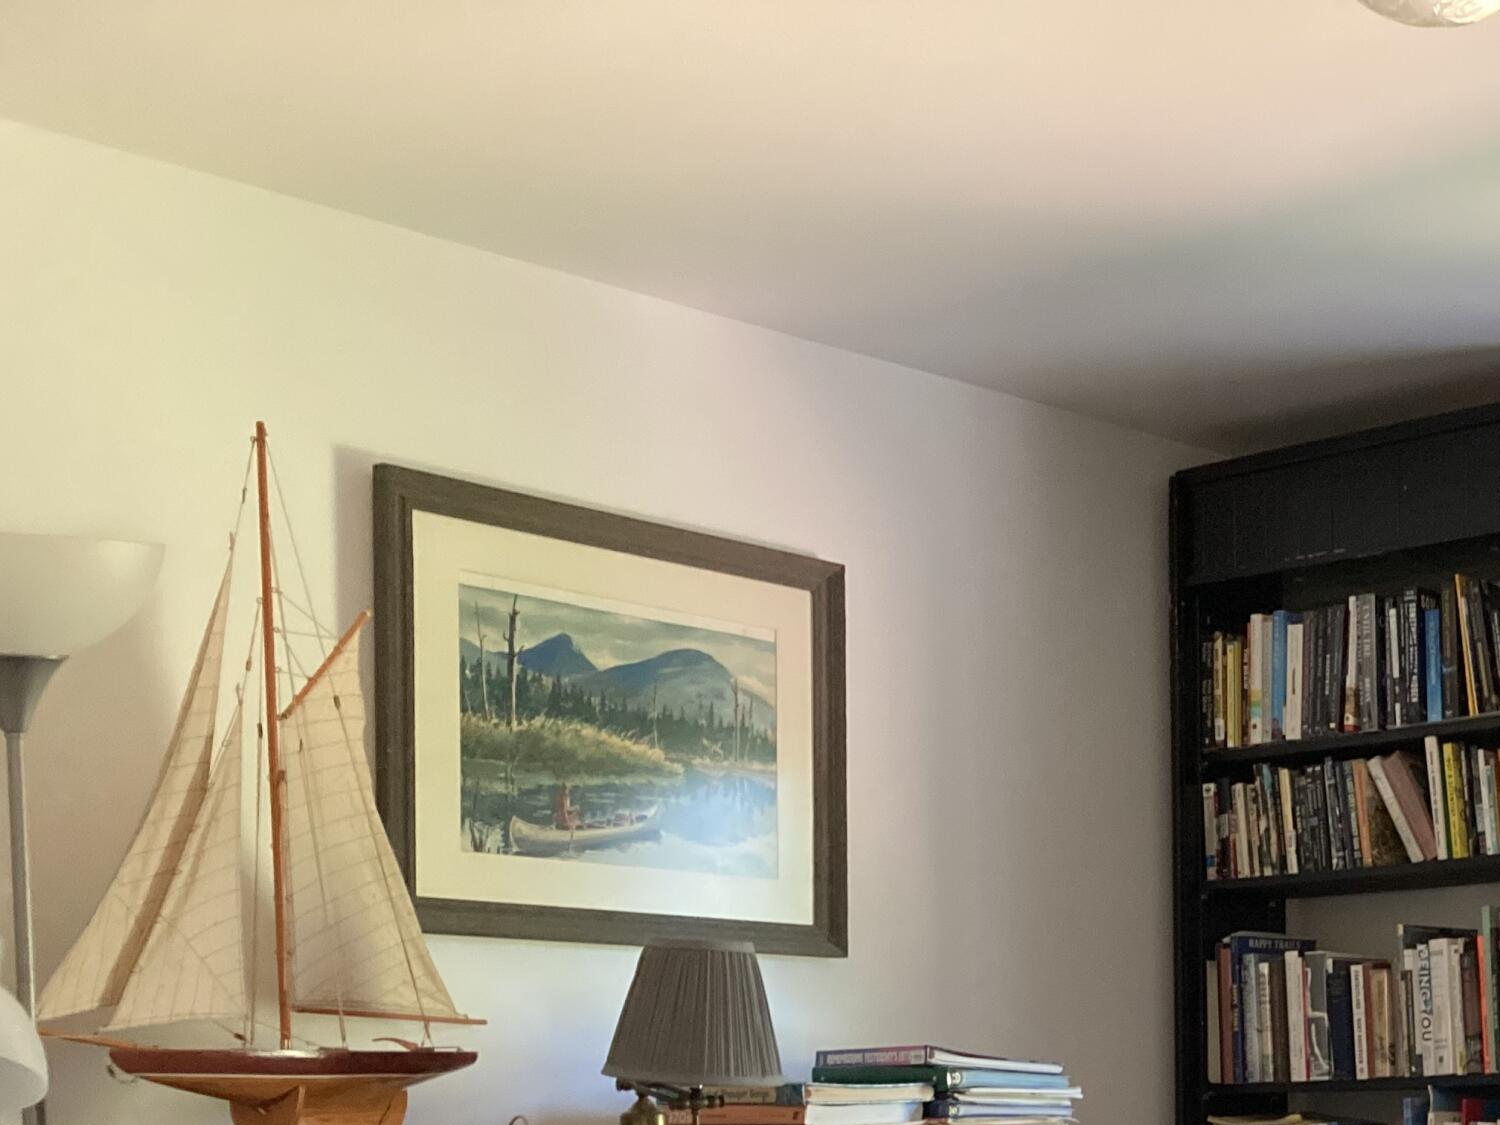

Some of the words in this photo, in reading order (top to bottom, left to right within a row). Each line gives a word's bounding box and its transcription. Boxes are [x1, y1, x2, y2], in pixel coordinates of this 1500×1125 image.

[1248, 938, 1272, 949] HAPPY
[1417, 948, 1431, 1002] BEING
[1421, 1006, 1433, 1042] YOU
